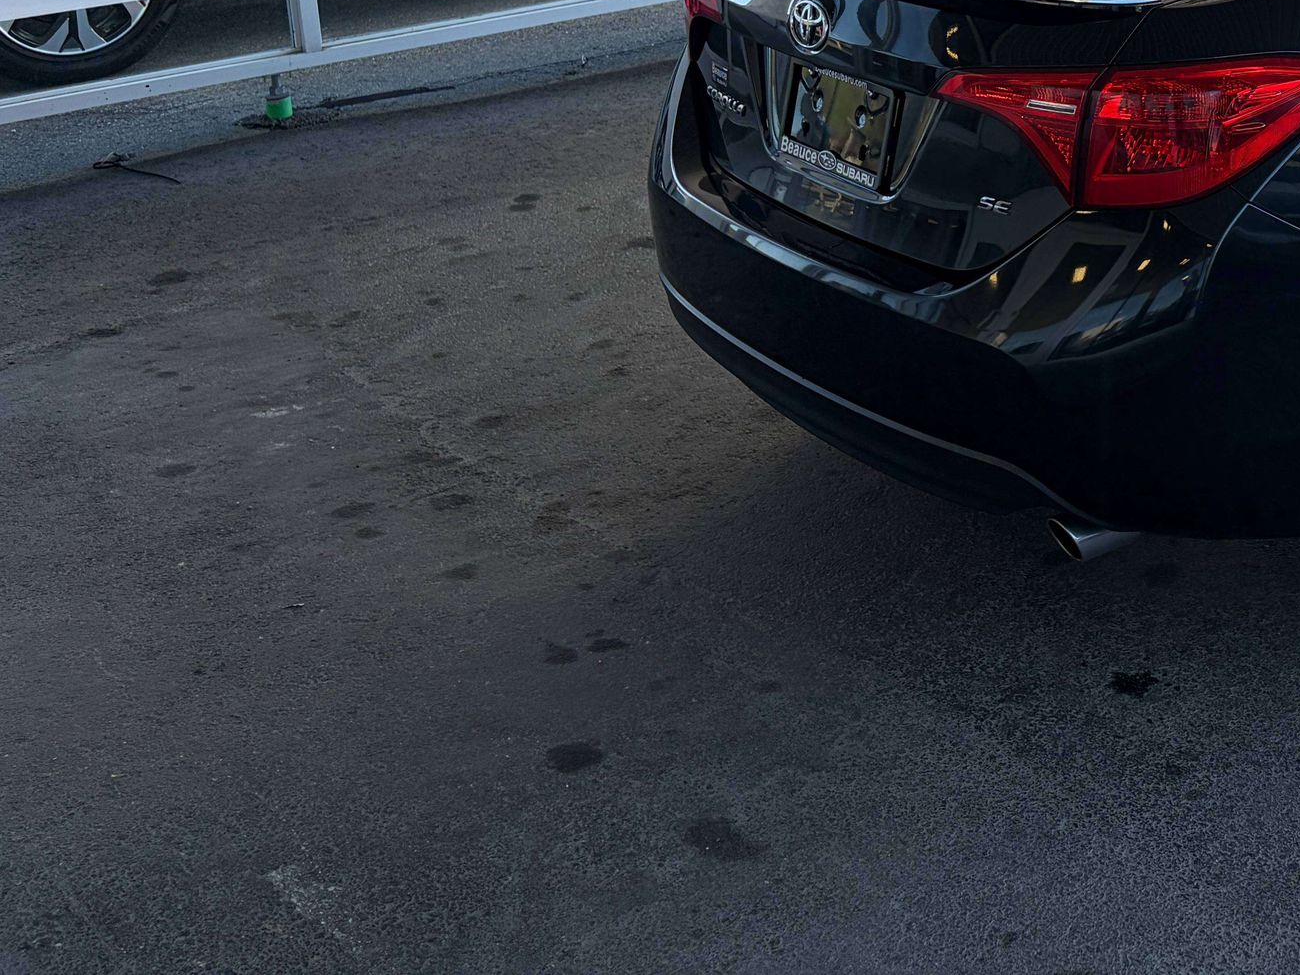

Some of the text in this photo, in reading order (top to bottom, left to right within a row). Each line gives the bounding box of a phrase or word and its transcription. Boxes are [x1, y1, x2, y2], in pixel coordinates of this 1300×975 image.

[706, 85, 746, 116] COROLLA
[780, 135, 818, 164] Beauce
[835, 163, 876, 188] SUBARU
[976, 196, 1012, 215] SE
